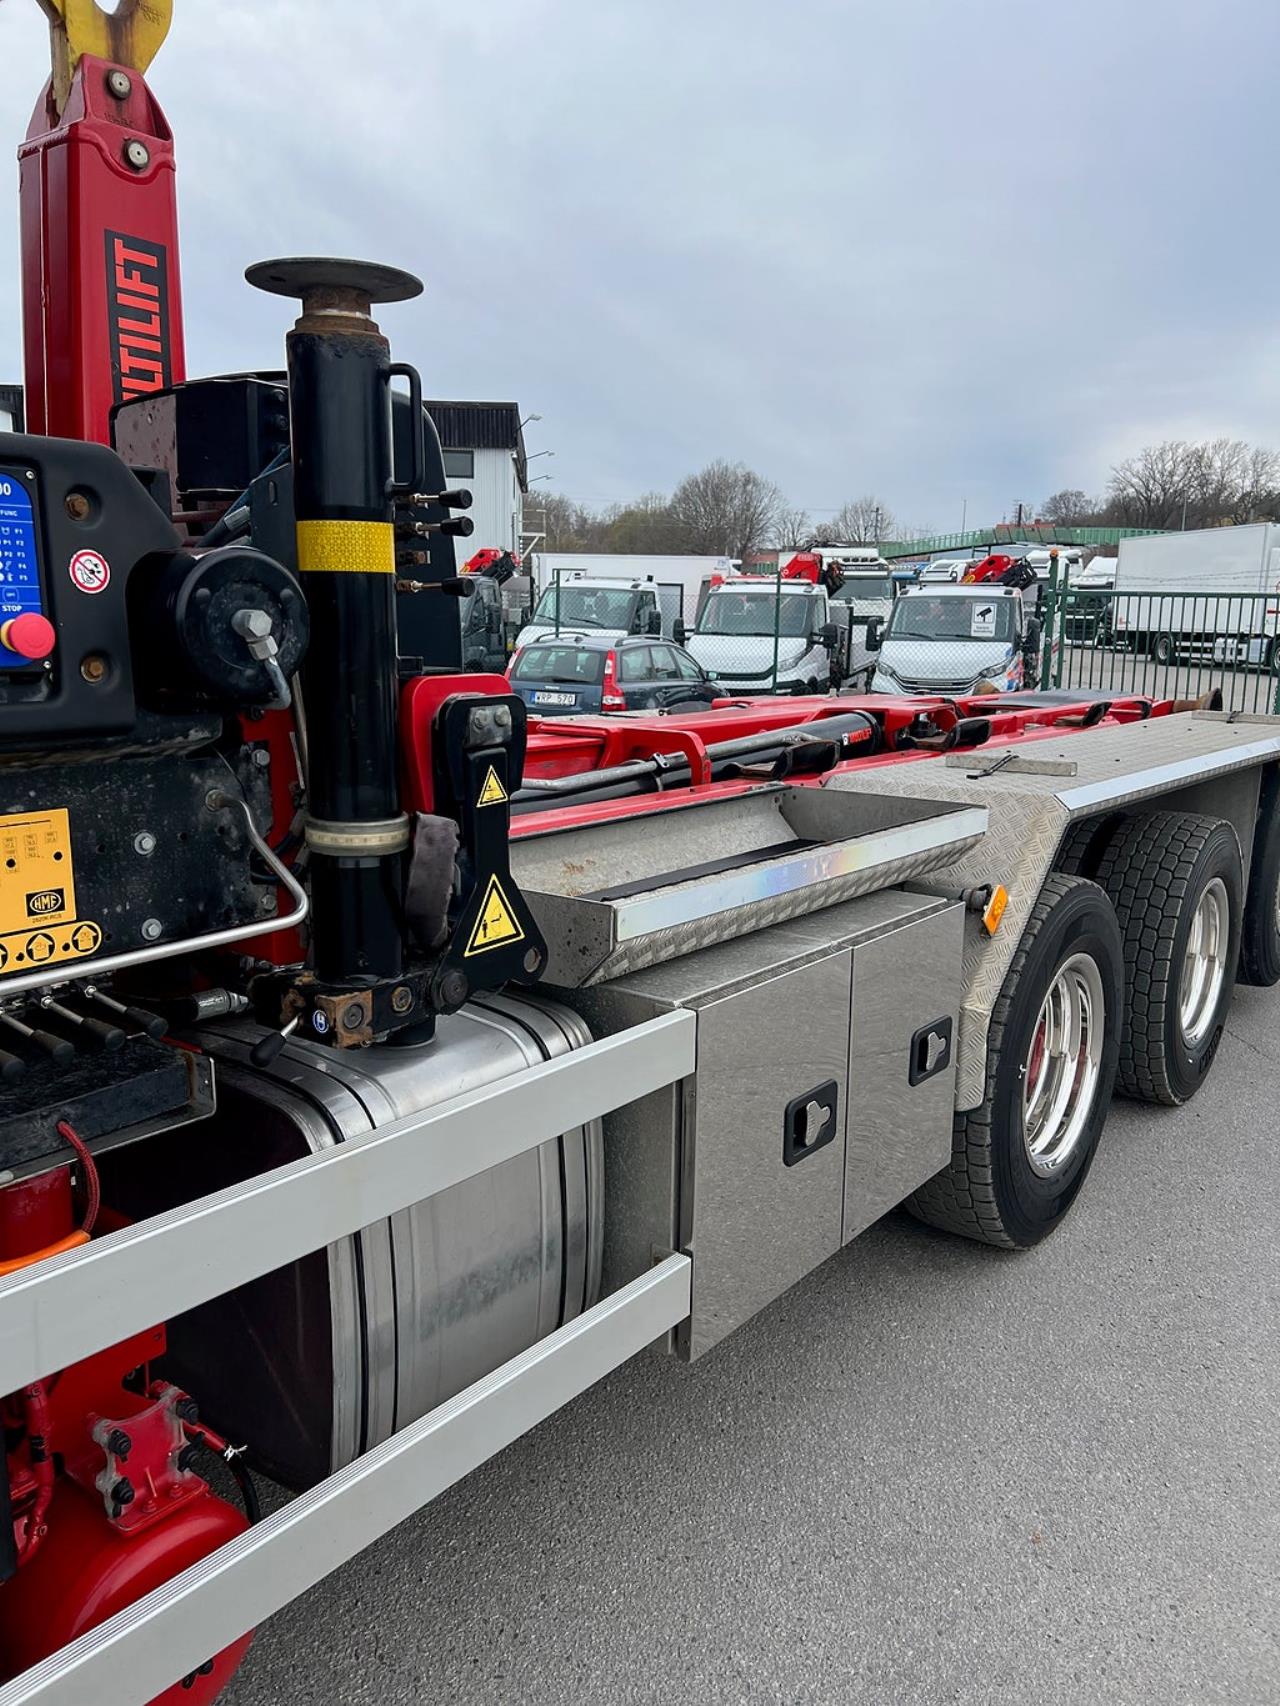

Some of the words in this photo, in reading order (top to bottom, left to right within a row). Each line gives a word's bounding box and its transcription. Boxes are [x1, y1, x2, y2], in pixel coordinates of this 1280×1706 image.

[114, 238, 164, 401] LTILIFT
[536, 692, 552, 703] WRP
[557, 694, 573, 704] 570
[34, 894, 57, 910] HMF
